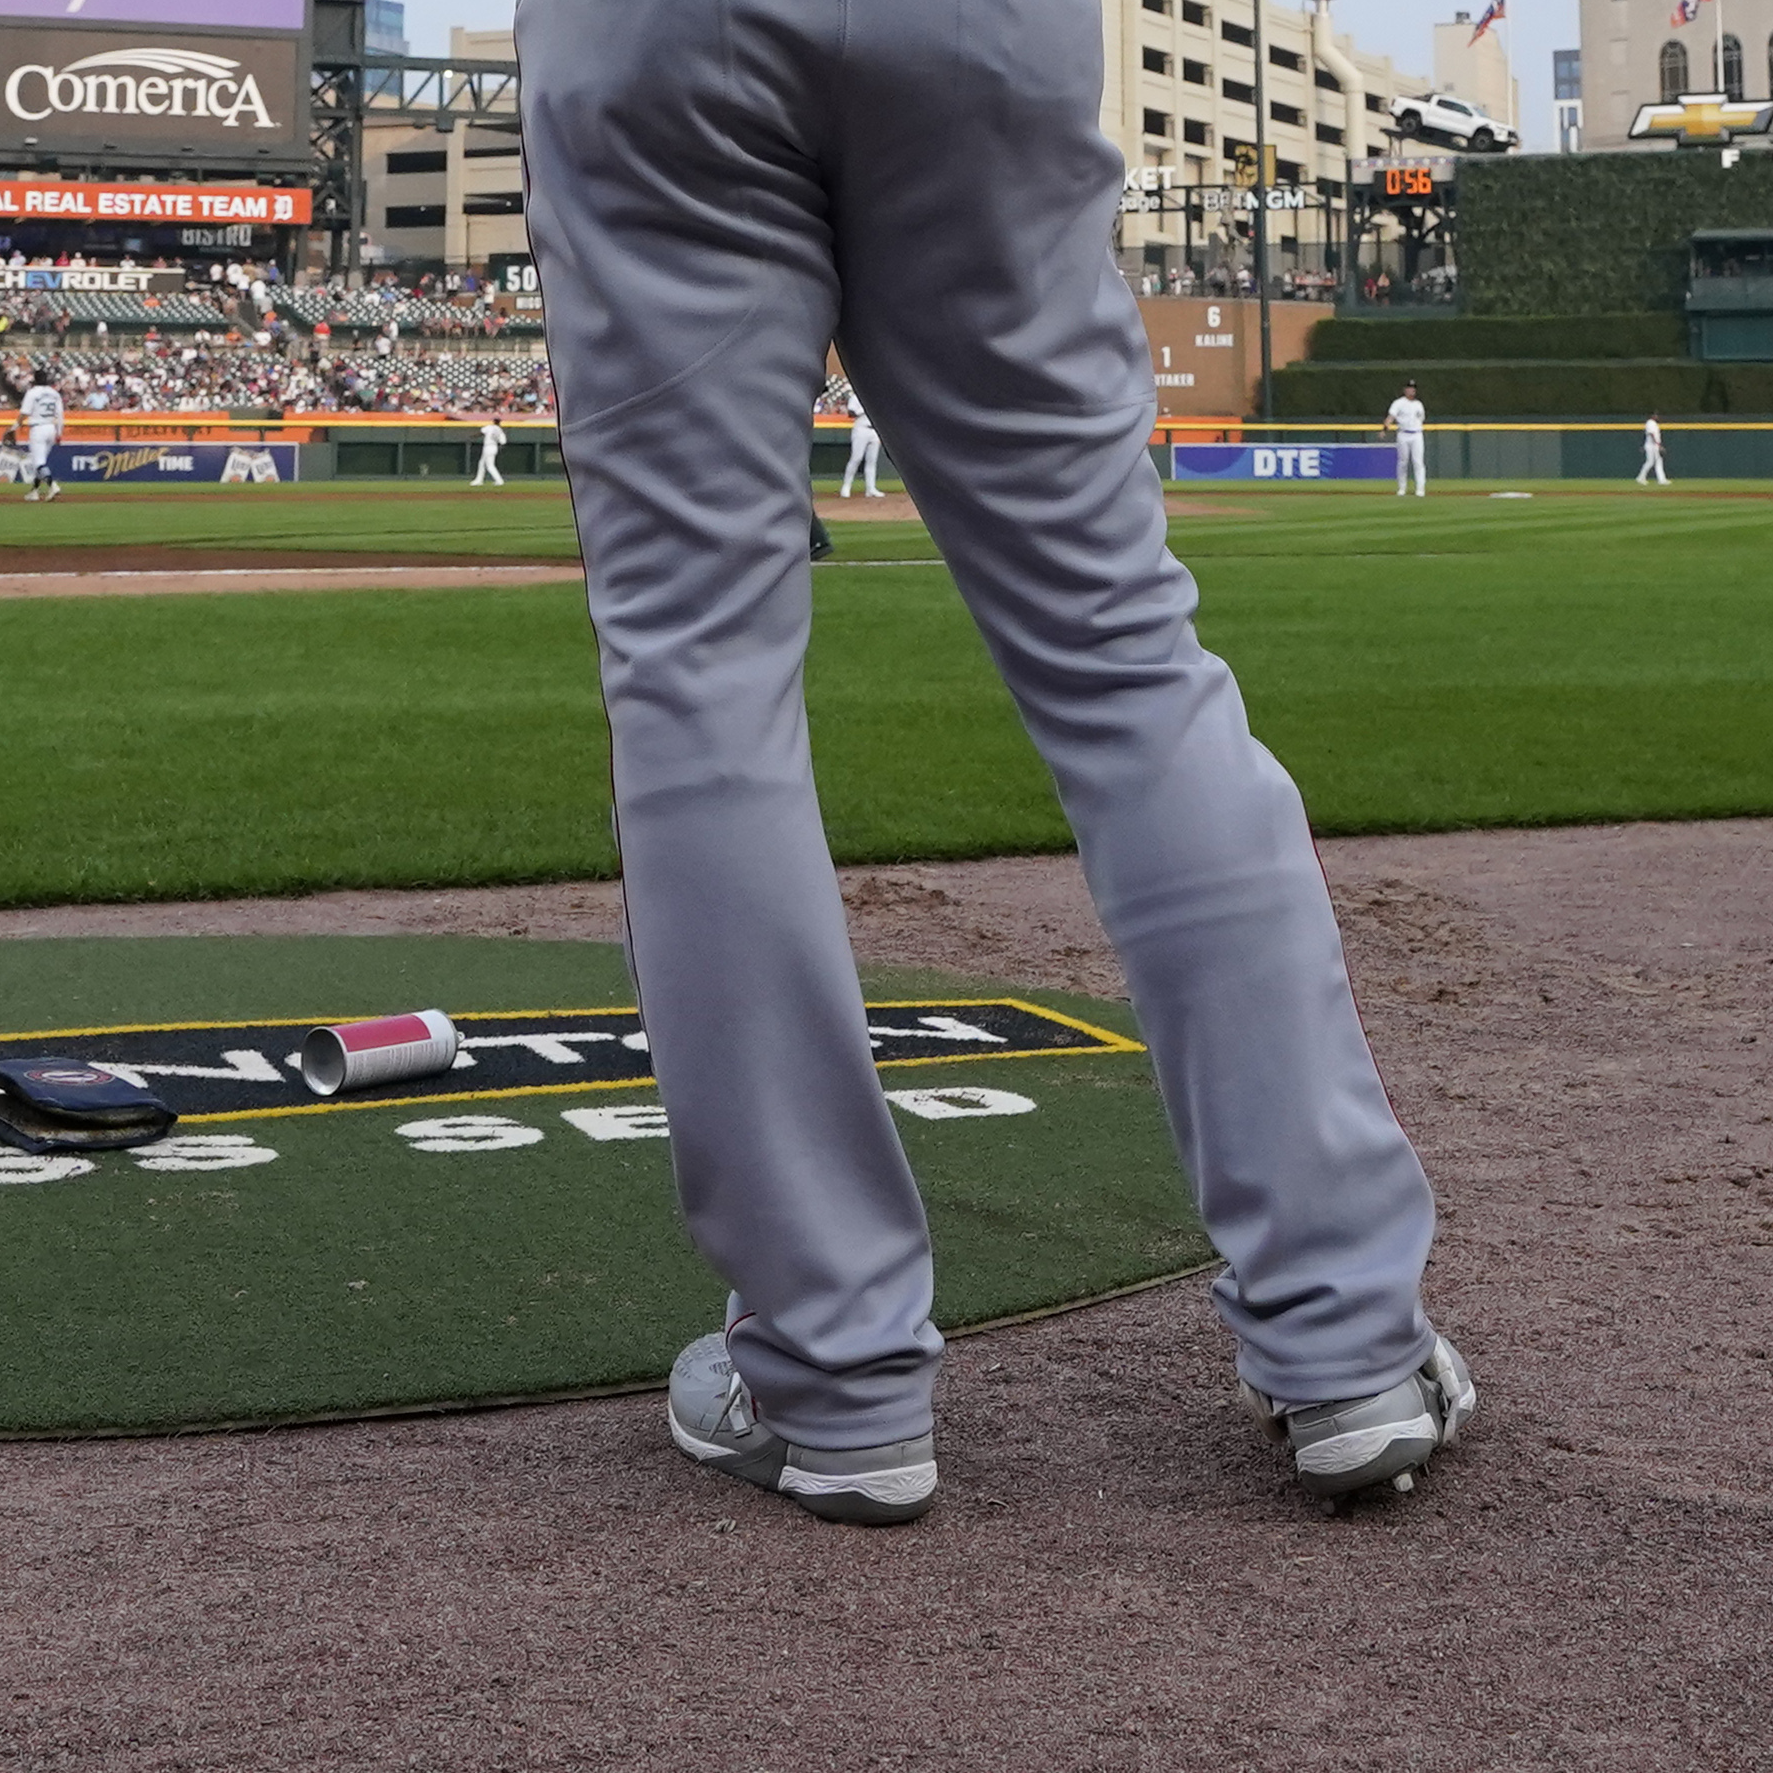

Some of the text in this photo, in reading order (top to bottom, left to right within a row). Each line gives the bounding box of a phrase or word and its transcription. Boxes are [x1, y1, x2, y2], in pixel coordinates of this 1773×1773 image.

[26, 192, 92, 214] REAL
[98, 193, 193, 216] ESTATE
[199, 195, 267, 218] TEAM
[1207, 305, 1221, 328] 6
[1161, 346, 1171, 368] 1
[158, 455, 194, 472] TIME
[1253, 449, 1321, 477] DTE
